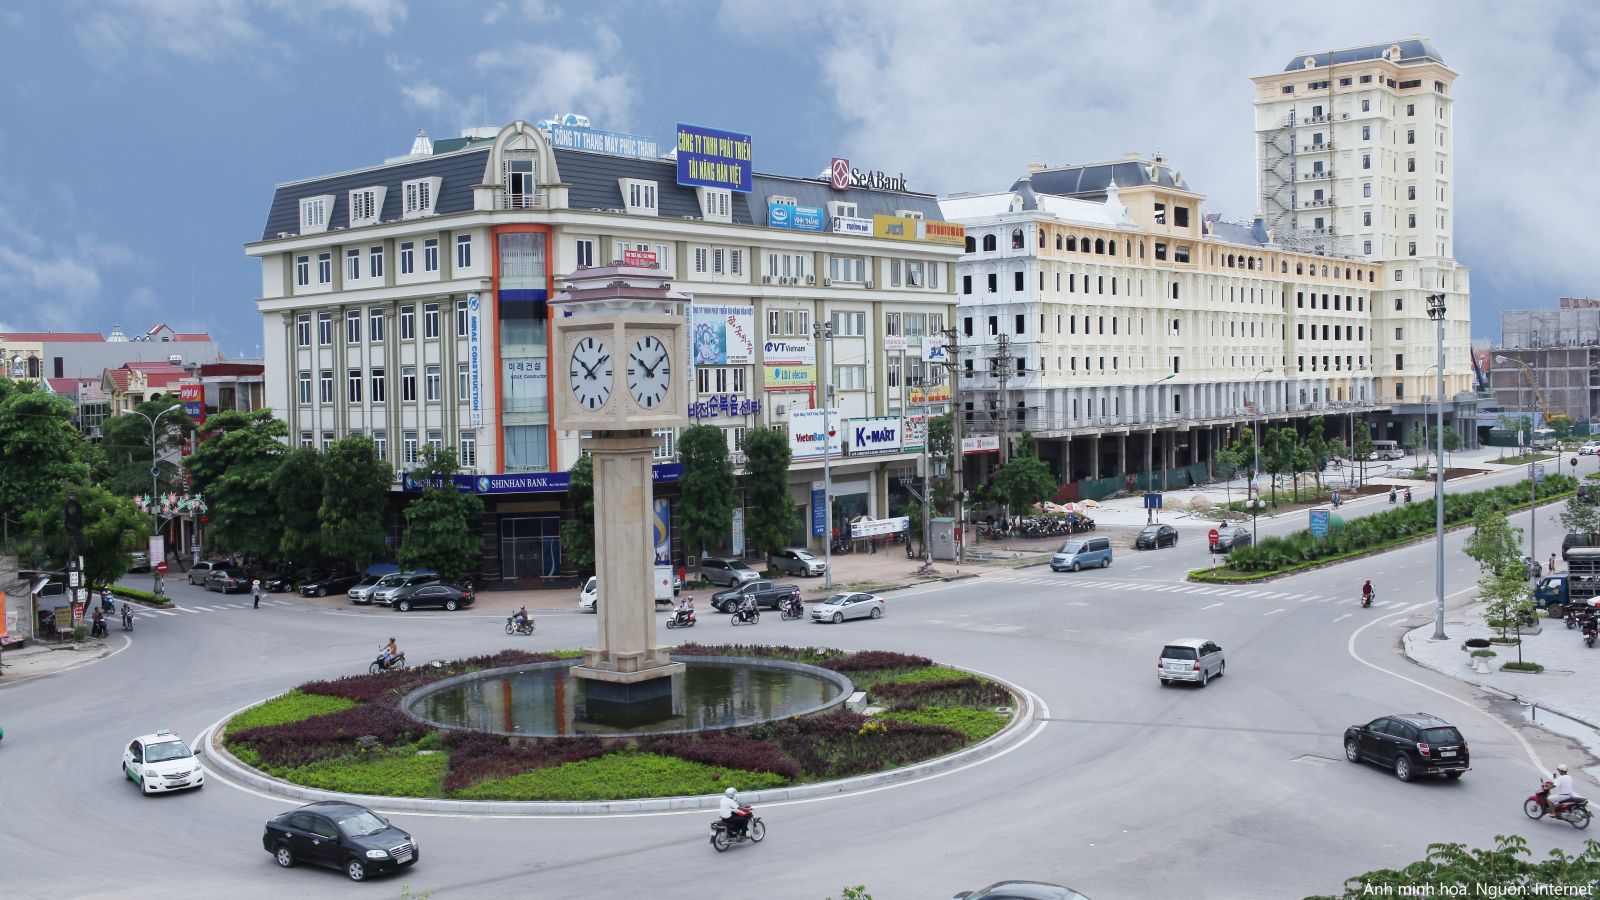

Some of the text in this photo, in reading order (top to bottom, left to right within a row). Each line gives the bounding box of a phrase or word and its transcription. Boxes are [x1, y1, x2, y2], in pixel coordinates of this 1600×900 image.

[554, 126, 573, 146] CÔNG
[573, 131, 581, 148] TY
[677, 129, 751, 161] CÔNG TY TNHH PHÁT TRIỂN
[729, 163, 742, 188] VIỆT
[850, 168, 907, 191] SeABank
[471, 346, 479, 411] CONSTRUCTION
[795, 432, 828, 443] VietinBan
[856, 426, 896, 447] K-MART
[491, 477, 548, 489] SHINHAN BANK
